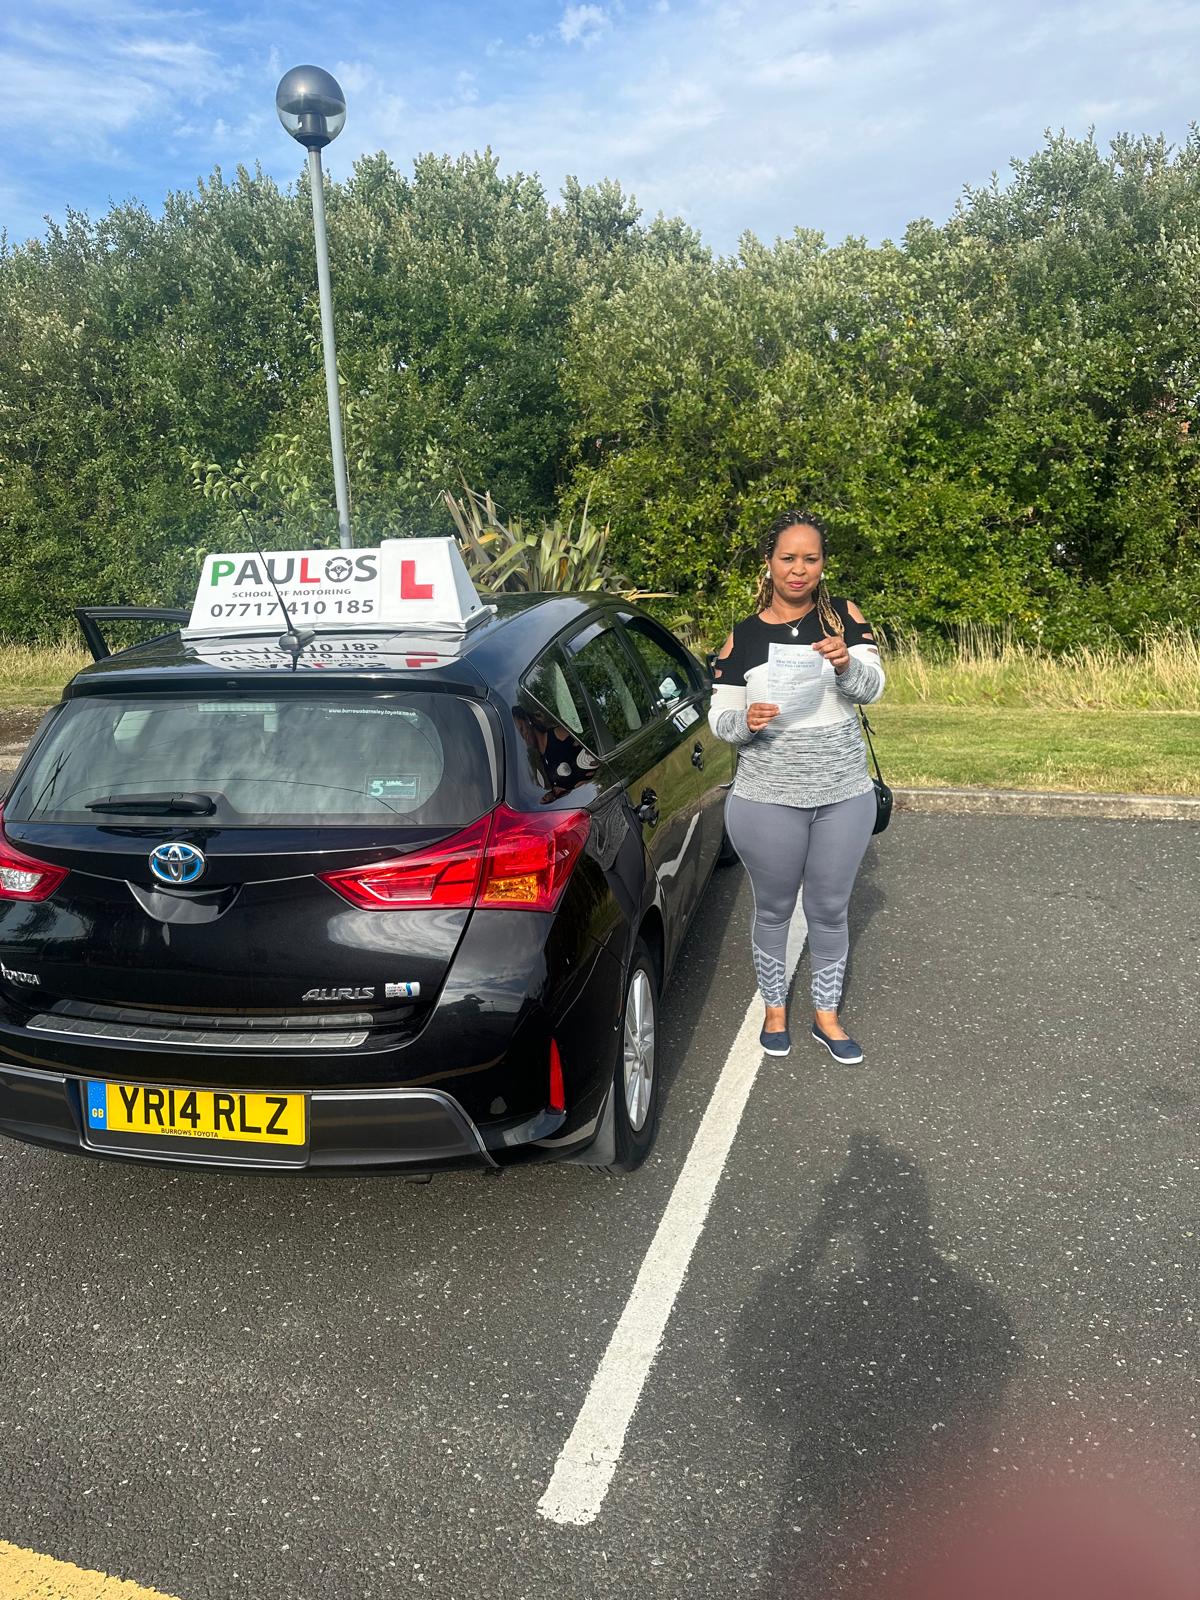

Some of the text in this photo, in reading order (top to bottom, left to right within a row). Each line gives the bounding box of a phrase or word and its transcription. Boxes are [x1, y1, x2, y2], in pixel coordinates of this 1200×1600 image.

[210, 554, 378, 587] PAULOS
[400, 559, 434, 600] L
[232, 590, 274, 598] SCHOOL
[292, 588, 352, 597] MOTORING
[210, 599, 374, 618] 07717 410 185
[370, 780, 384, 796] 5
[2, 968, 41, 985] TOYOTA
[302, 986, 376, 1001] AURIS
[91, 1108, 104, 1118] GB
[119, 1086, 289, 1136] YR14 RLZ
[160, 1127, 219, 1138] BURROWS TOYOTA
